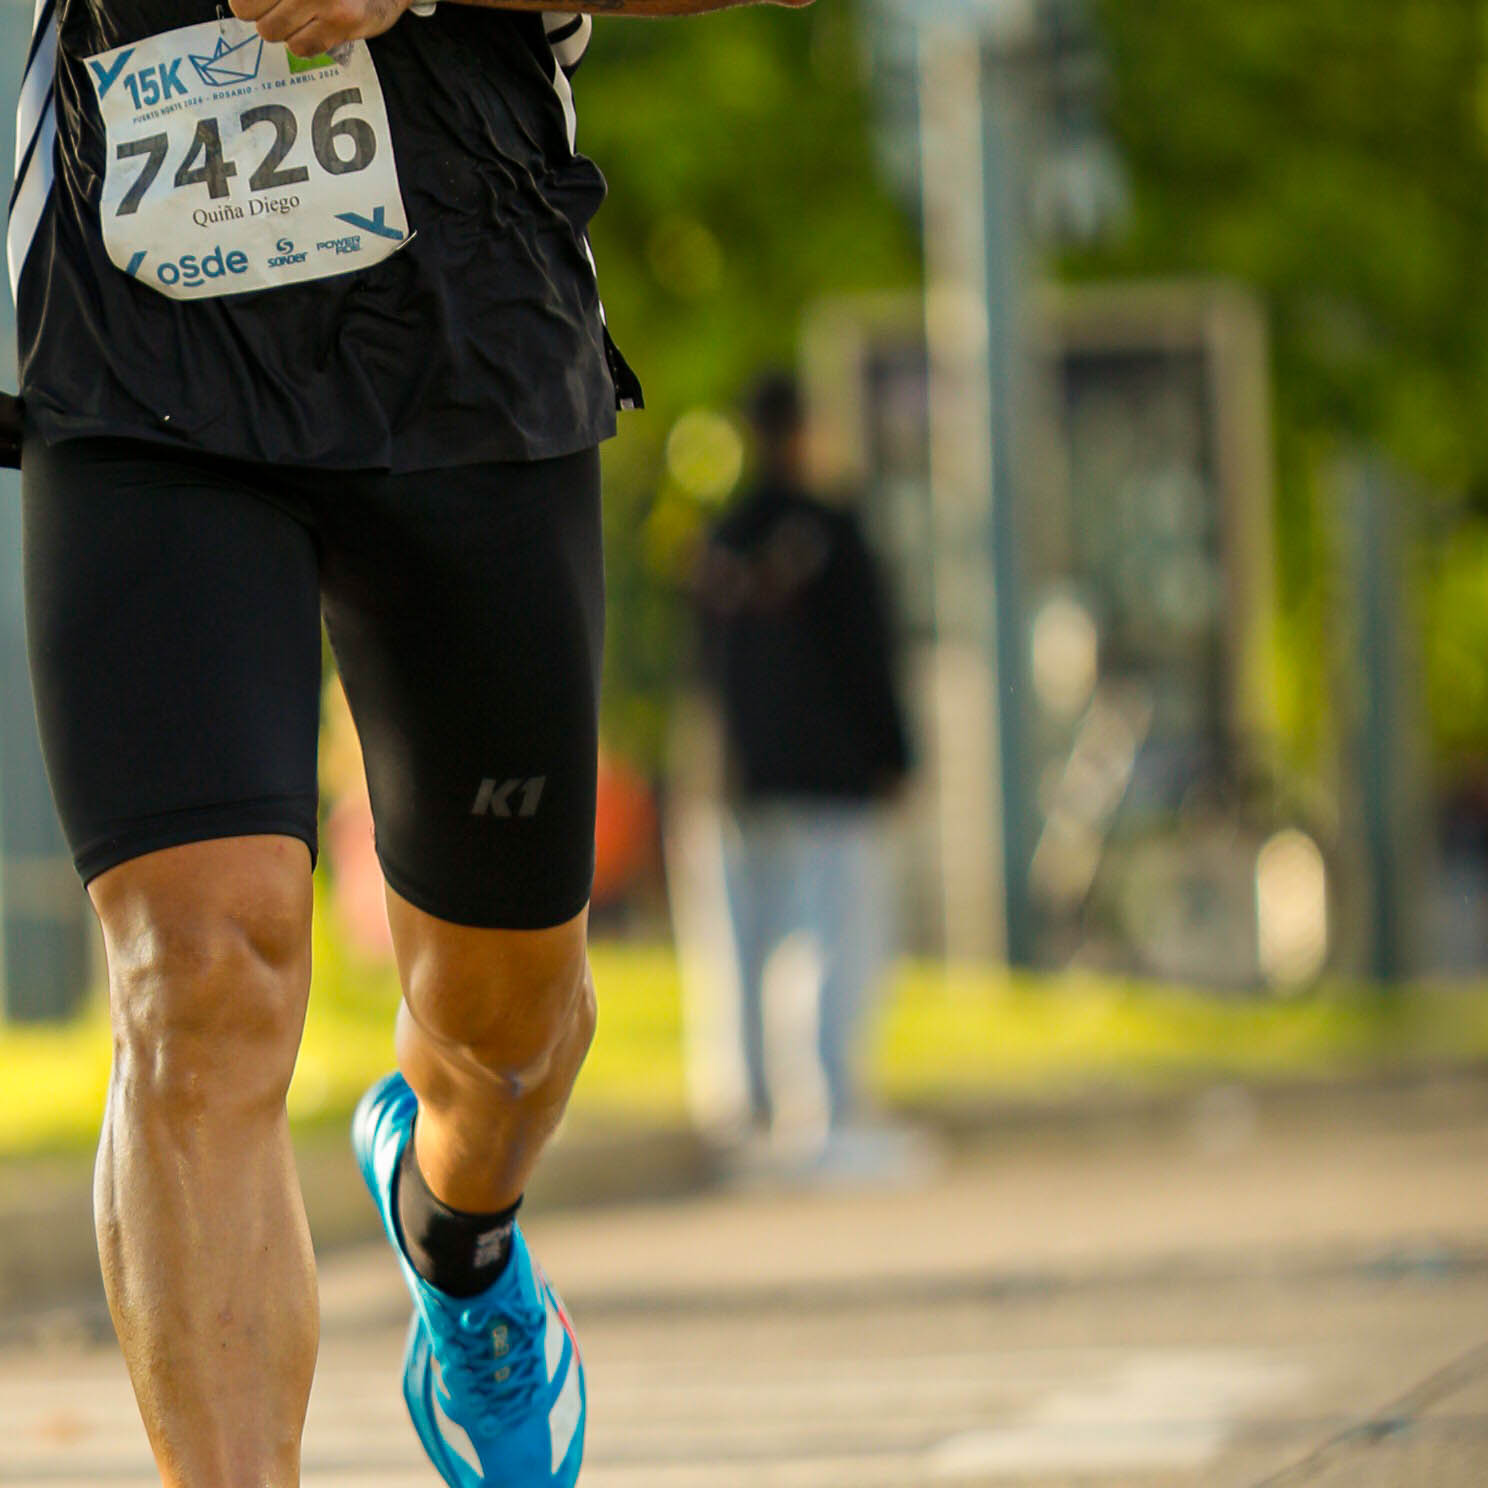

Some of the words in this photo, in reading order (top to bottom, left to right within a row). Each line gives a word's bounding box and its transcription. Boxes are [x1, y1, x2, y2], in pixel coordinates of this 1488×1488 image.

[123, 57, 188, 110] 15K
[160, 102, 183, 115] NORTE
[213, 86, 252, 100] ROSARIO
[262, 81, 272, 90] 12
[275, 79, 286, 88] DE
[290, 74, 316, 86] ABRIL
[115, 87, 377, 217] 7426
[192, 206, 245, 228] Quiña
[248, 195, 300, 217] Diego
[316, 235, 361, 252] POWER
[156, 244, 249, 287] osde
[471, 775, 547, 818] K1
